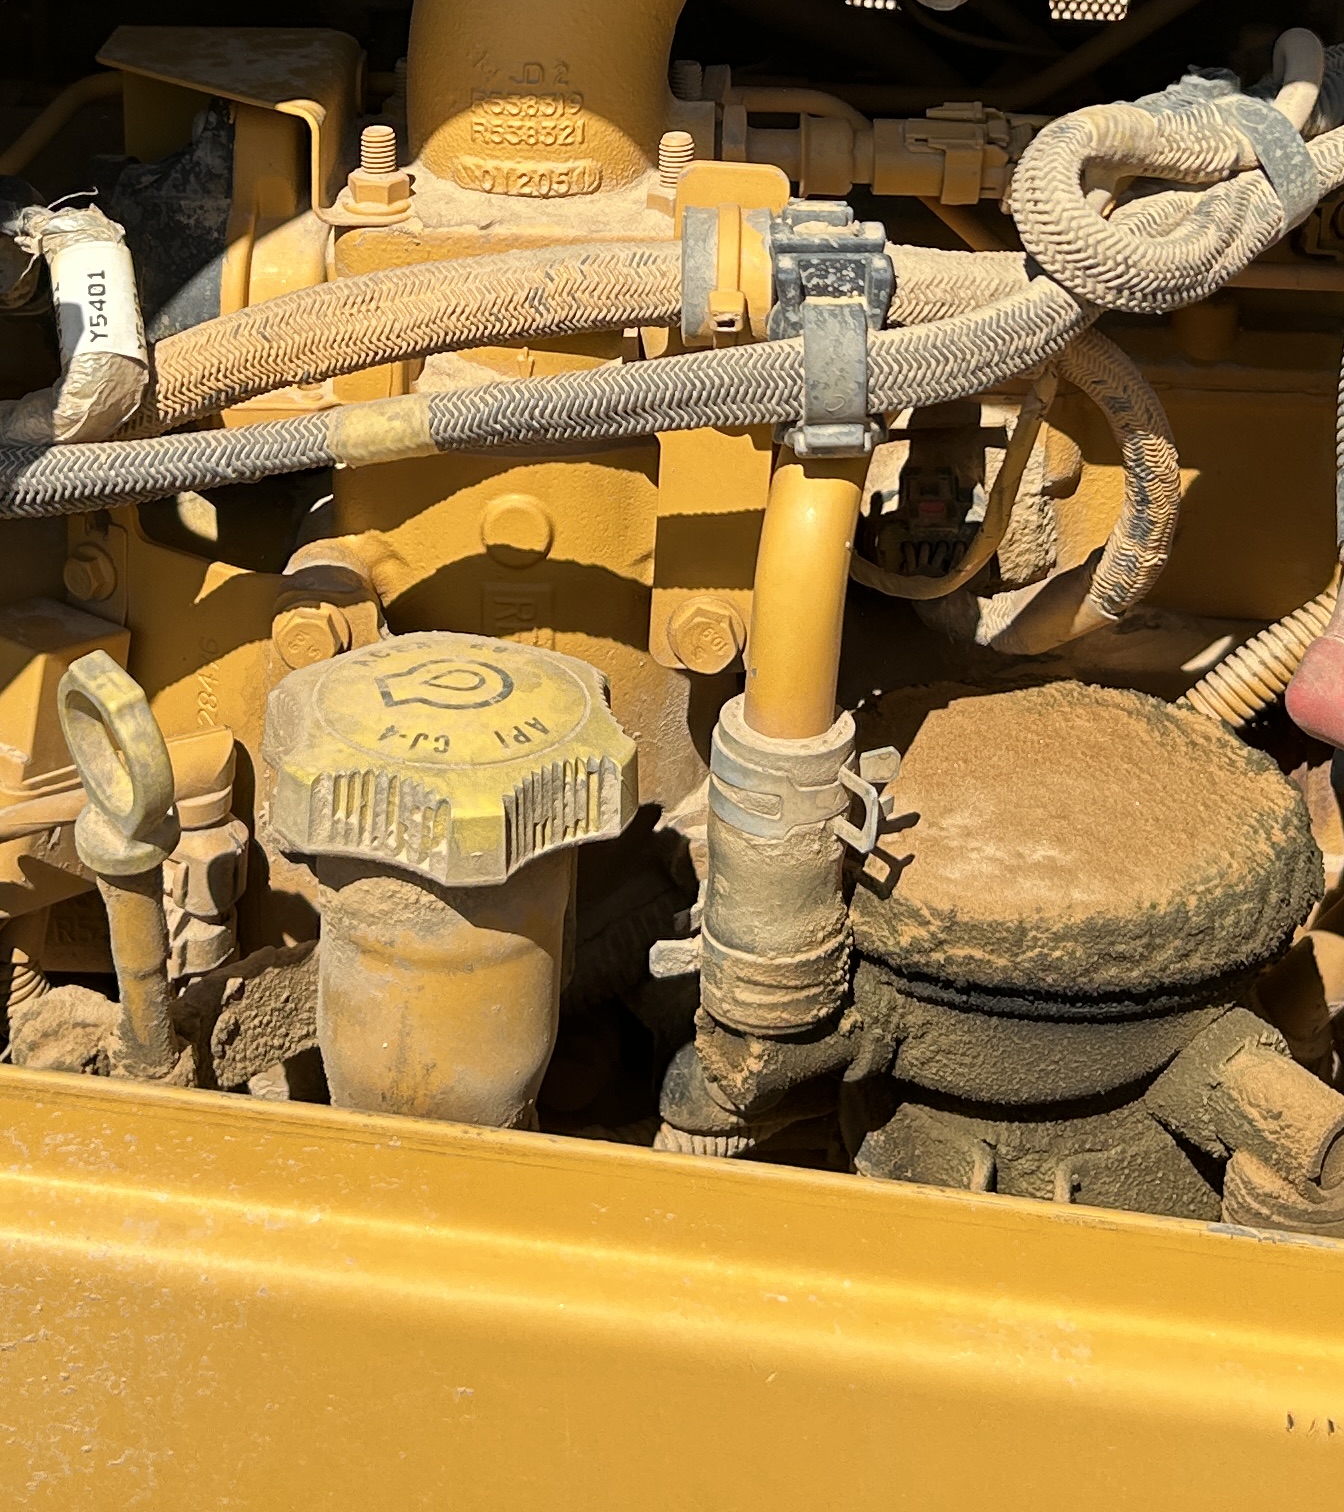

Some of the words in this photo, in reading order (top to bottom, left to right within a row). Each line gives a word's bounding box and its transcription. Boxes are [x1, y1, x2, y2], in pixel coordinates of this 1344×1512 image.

[87, 270, 109, 343] Y5401
[376, 724, 451, 754] CJ-4
[493, 716, 551, 749] API
